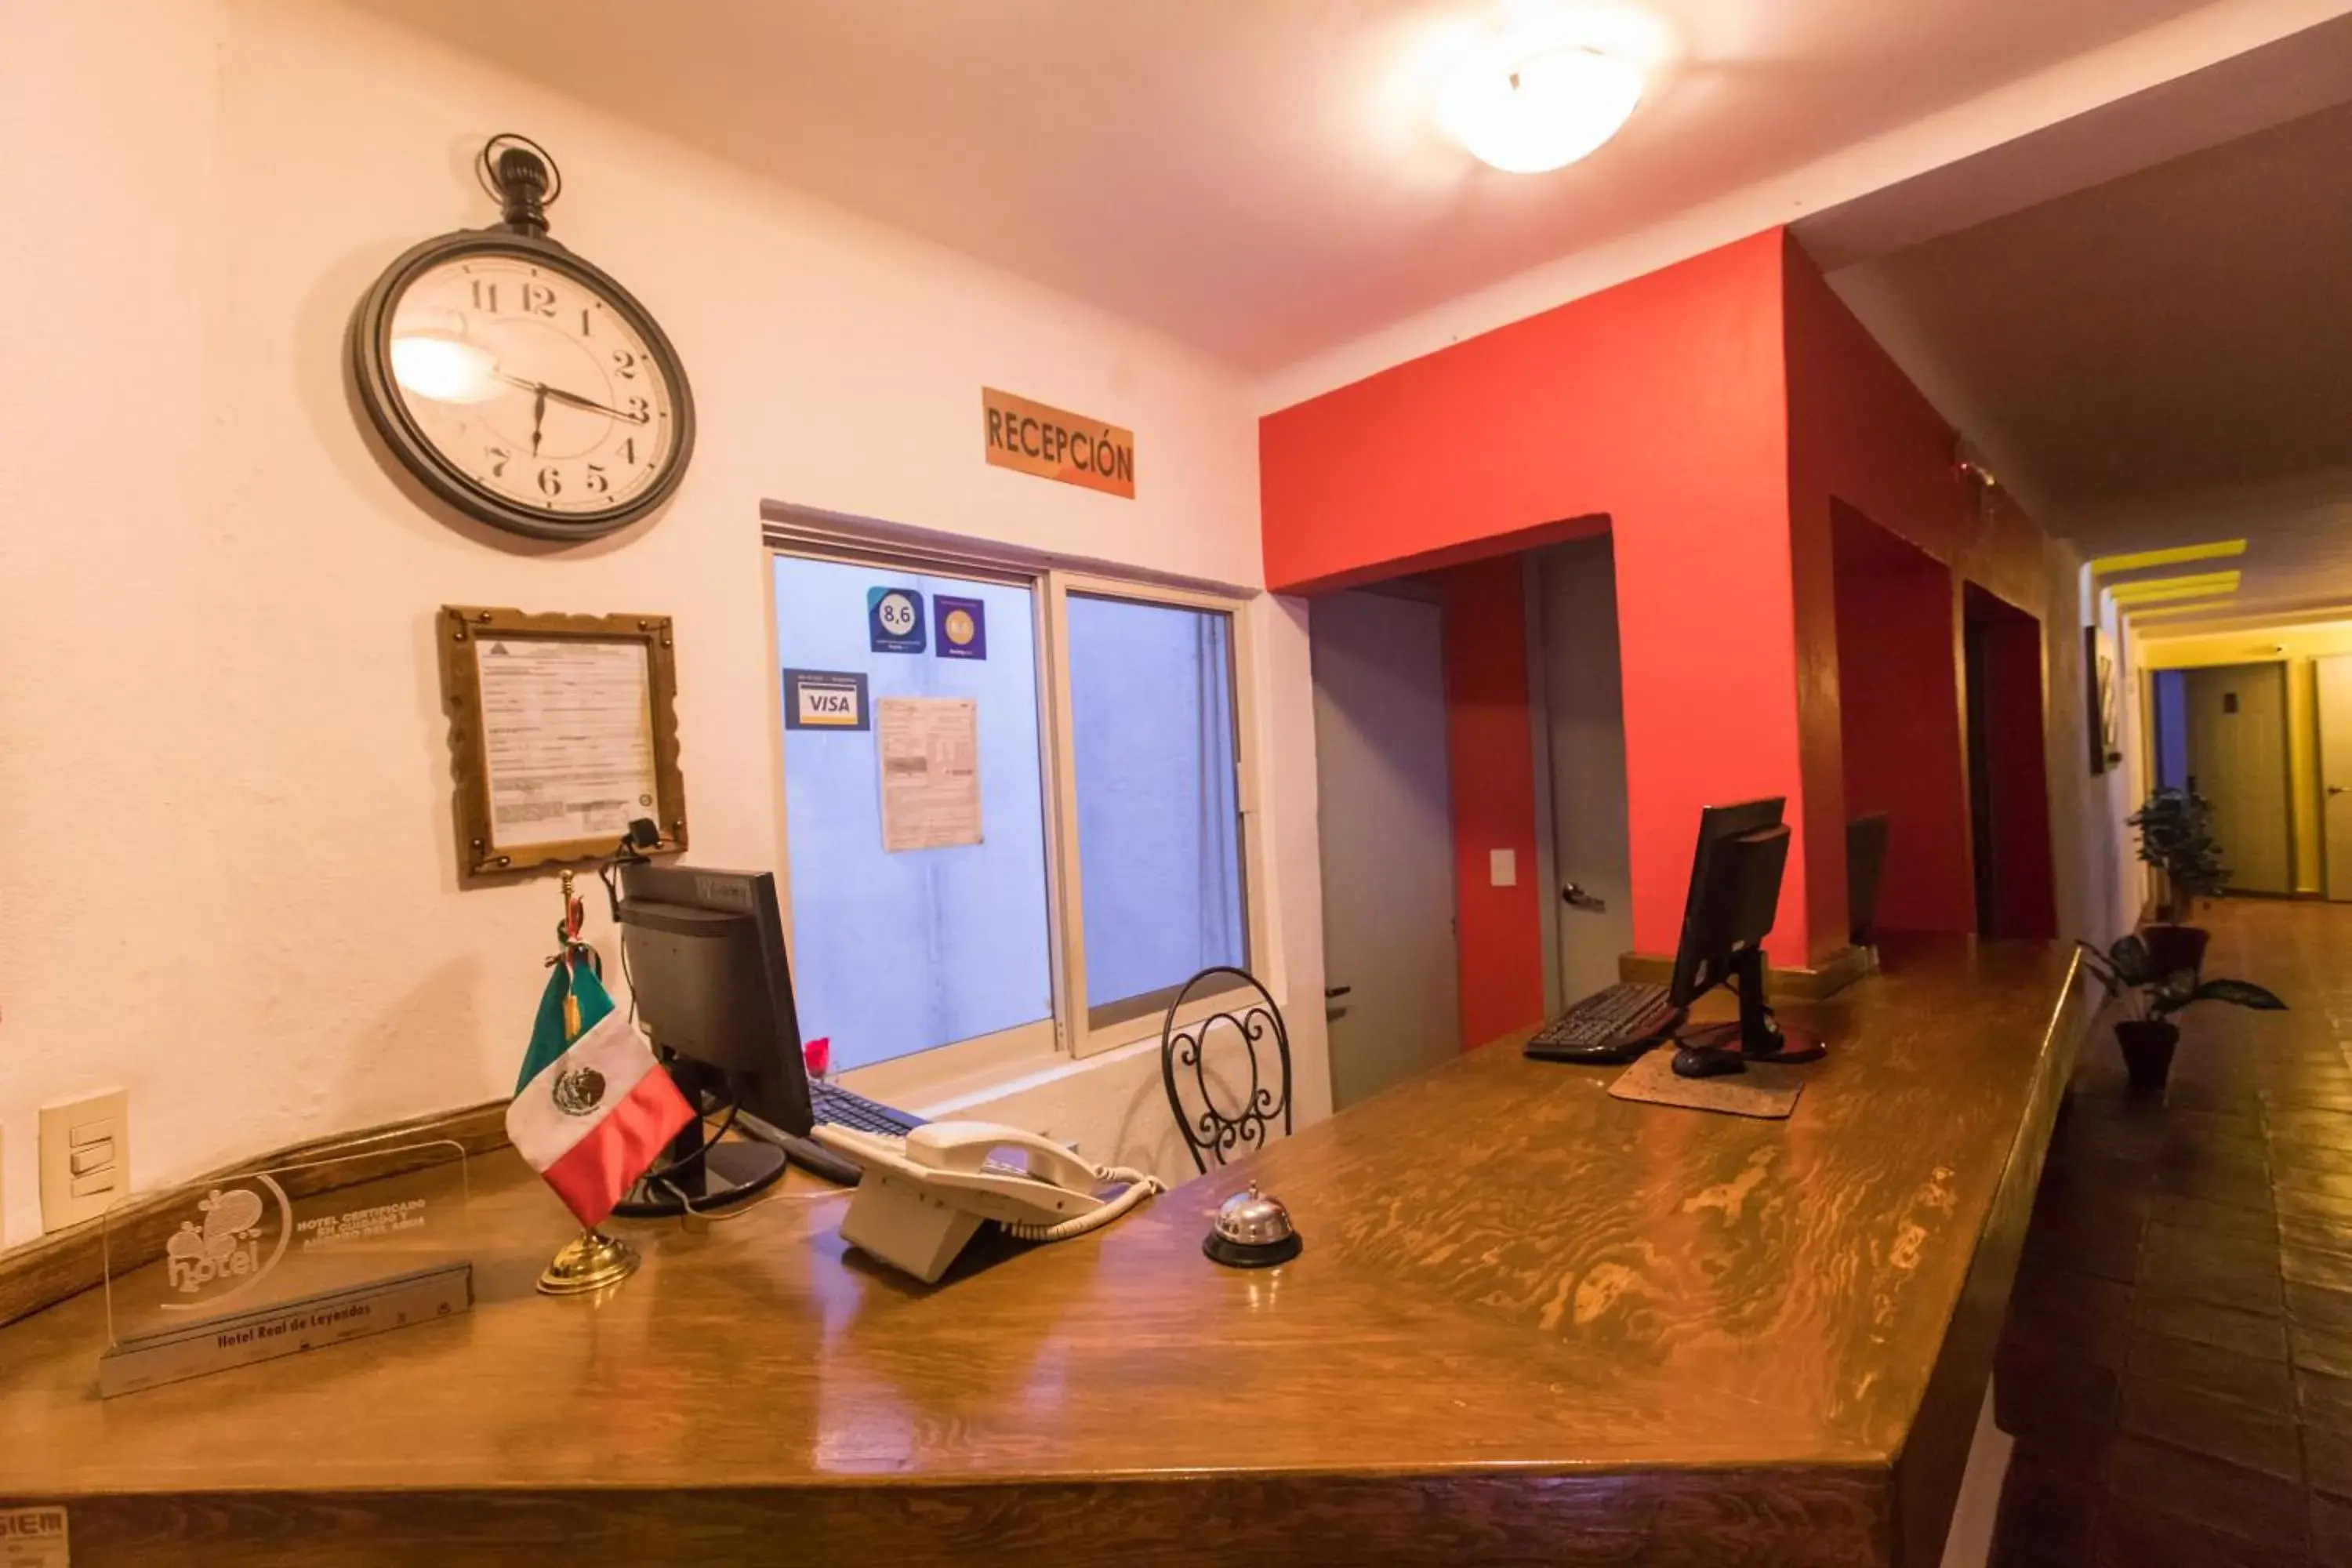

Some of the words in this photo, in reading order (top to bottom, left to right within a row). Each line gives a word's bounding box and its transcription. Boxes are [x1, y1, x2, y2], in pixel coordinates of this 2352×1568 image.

[471, 279, 498, 313] 11
[521, 282, 557, 318] 12
[580, 309, 593, 337] 1
[614, 349, 636, 380] 2
[629, 396, 651, 423] 3
[615, 437, 640, 465] 4
[988, 407, 1132, 483] RECEPCIÓN
[484, 446, 512, 477] 7
[537, 468, 561, 496] 6
[586, 463, 608, 493] 5
[808, 695, 851, 713] VISA
[297, 1216, 339, 1232] HOTEL
[168, 1240, 258, 1287] hotel
[217, 1329, 254, 1349] Hotel
[257, 1320, 287, 1339] Real
[290, 1318, 308, 1331] de
[310, 1305, 372, 1327] Leyendas
